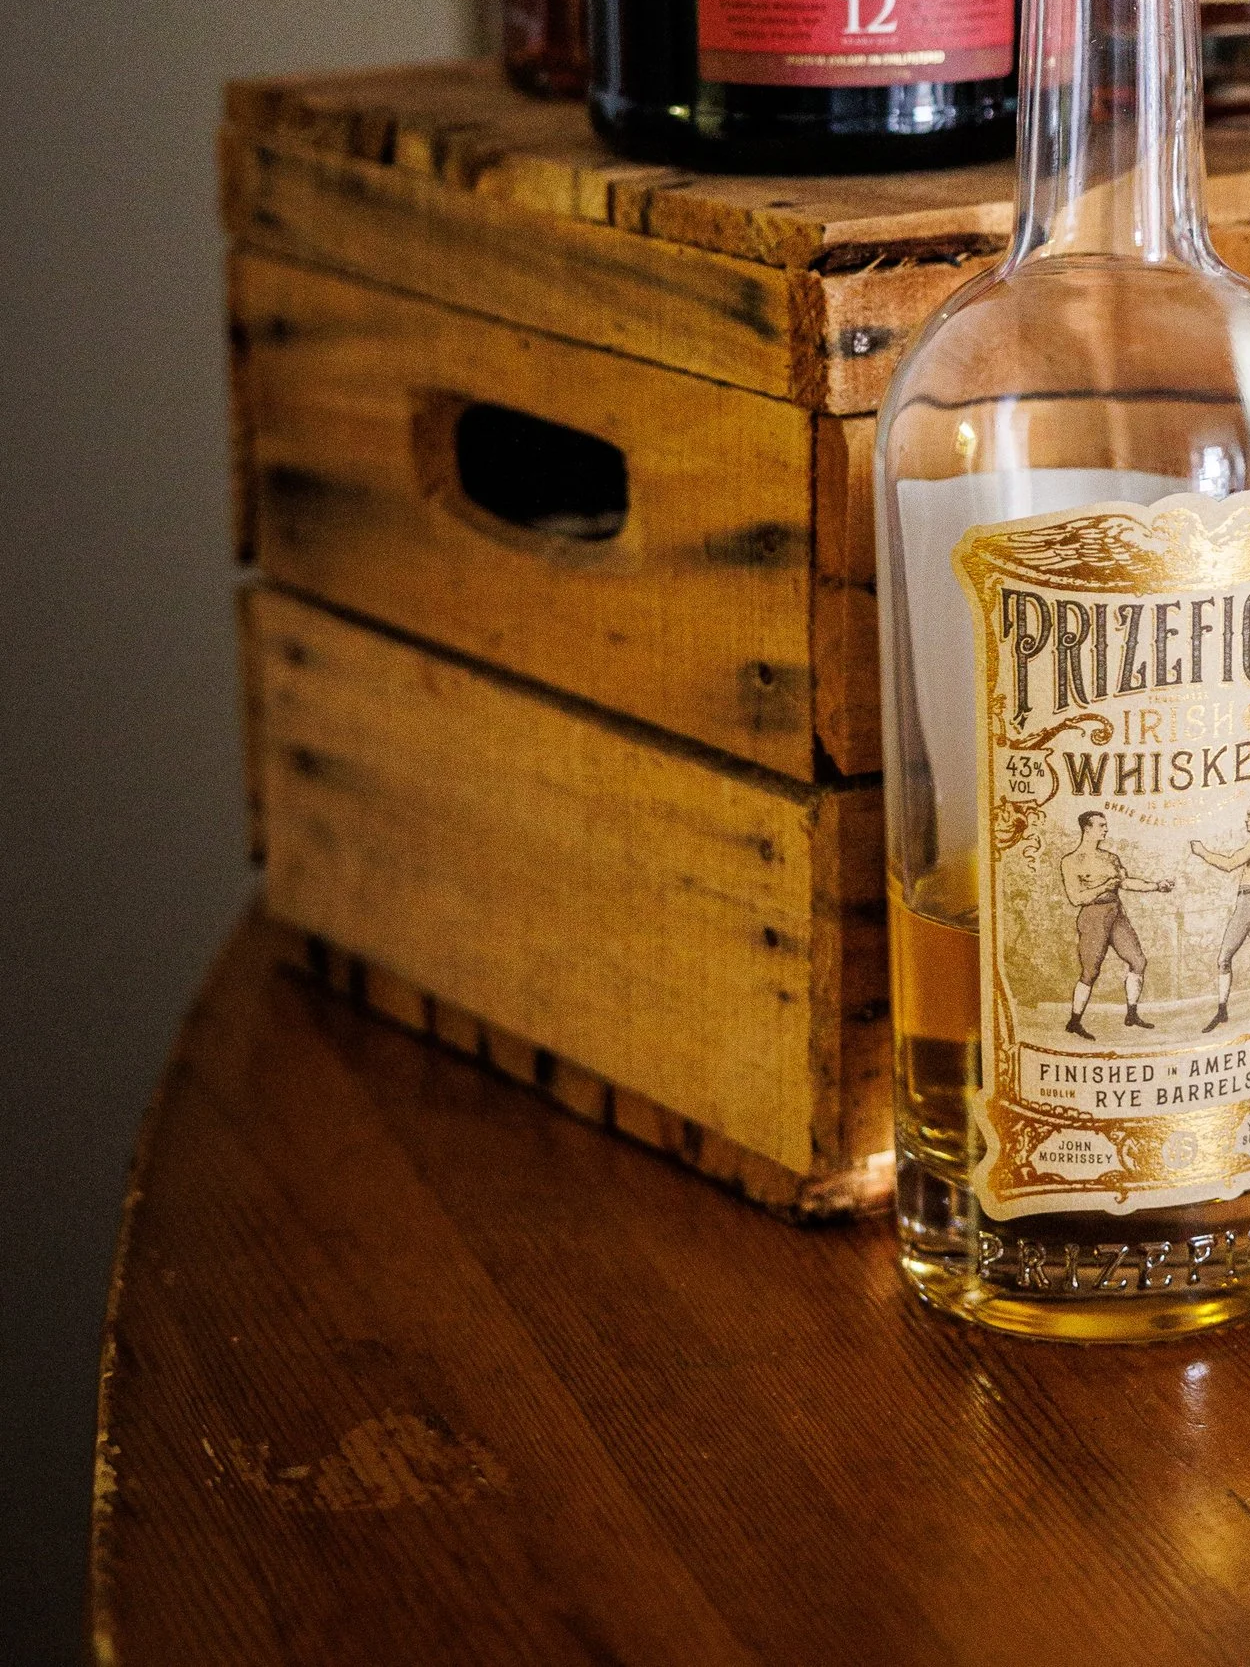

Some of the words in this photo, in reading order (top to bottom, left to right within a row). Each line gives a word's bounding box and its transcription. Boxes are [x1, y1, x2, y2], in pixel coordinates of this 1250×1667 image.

[1123, 701, 1235, 745] IRISH
[1006, 755, 1045, 778] 43%
[1009, 779, 1035, 794] VOL
[1040, 1063, 1154, 1084] FINISHED
[1167, 1066, 1178, 1077] IN
[1040, 1088, 1076, 1099] DUBLIN
[1096, 1090, 1142, 1108] RYE
[1059, 1140, 1092, 1152] JOHN
[1039, 1152, 1113, 1164] MORRISSEY
